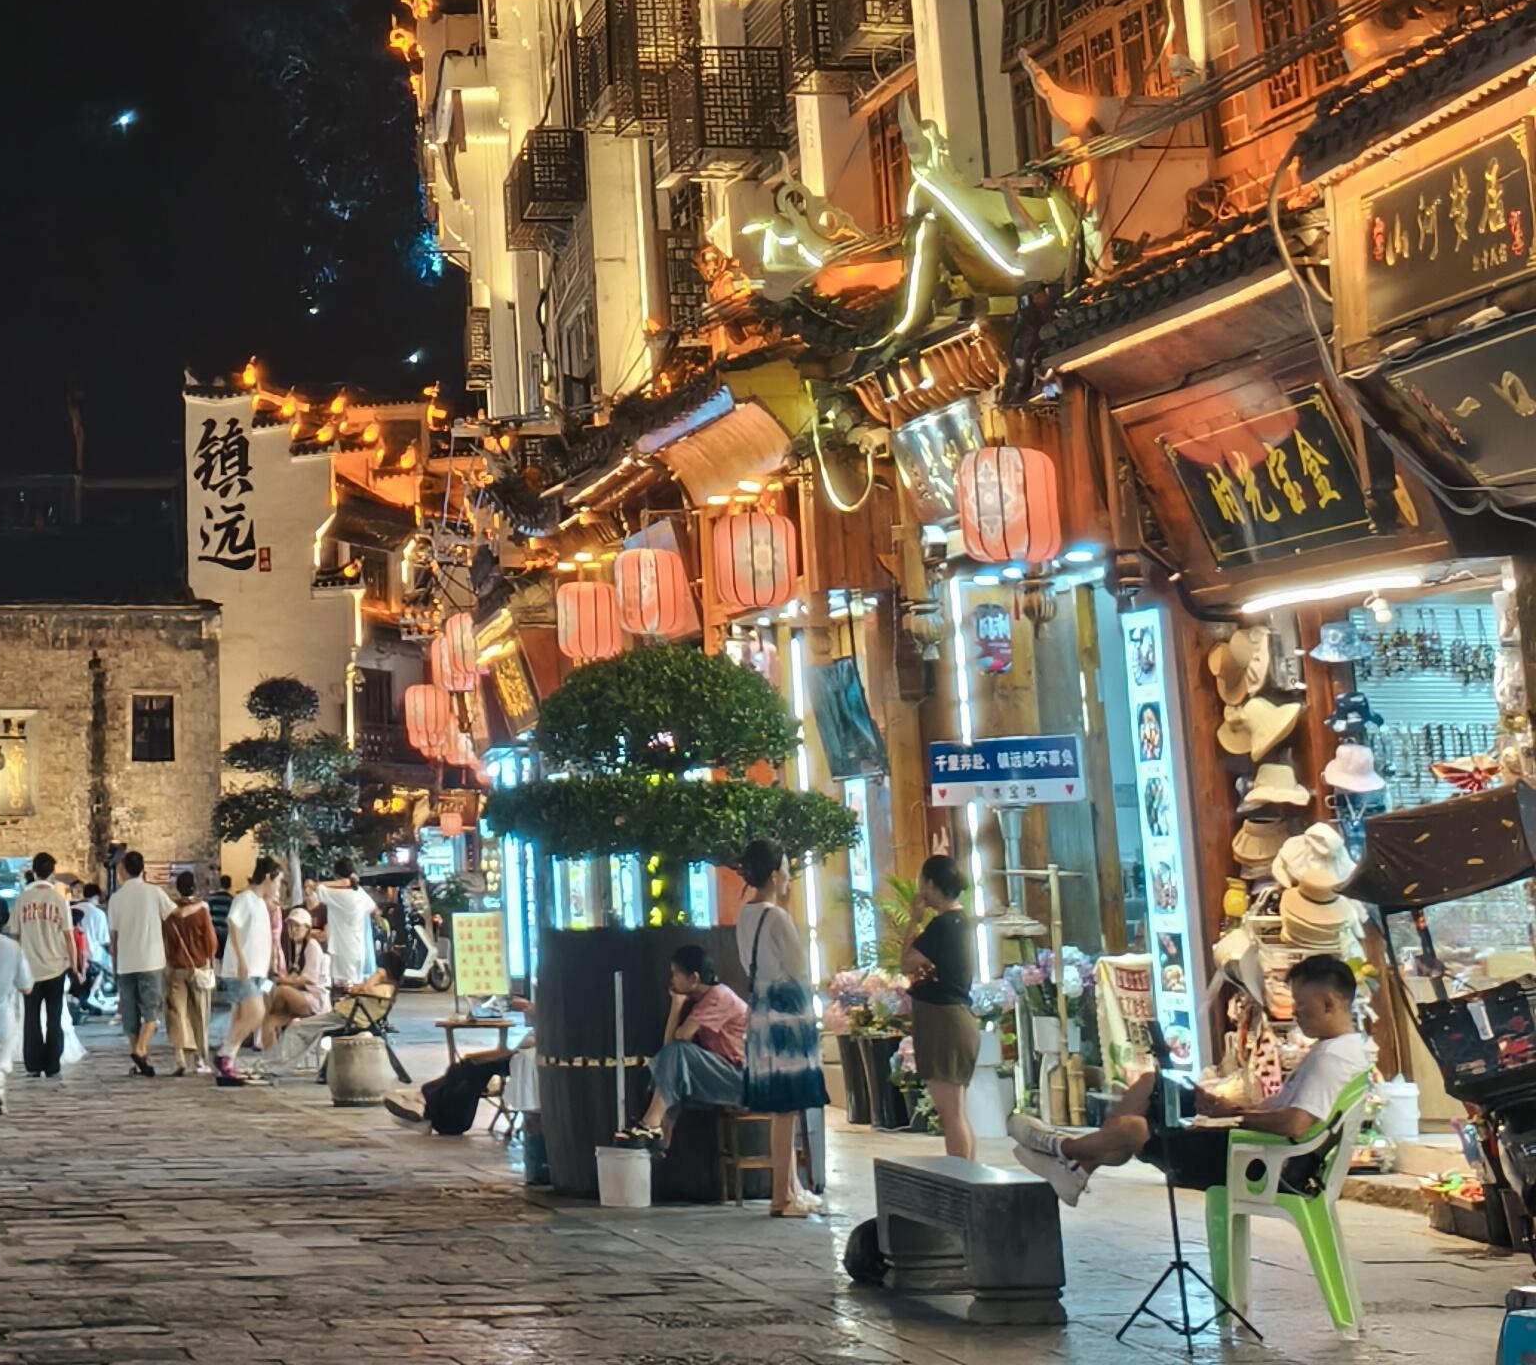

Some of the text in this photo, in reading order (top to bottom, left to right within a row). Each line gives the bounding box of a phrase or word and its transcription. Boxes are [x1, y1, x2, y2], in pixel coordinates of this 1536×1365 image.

[193, 417, 257, 571] 镇远
[1206, 428, 1342, 525] 时光宝盒
